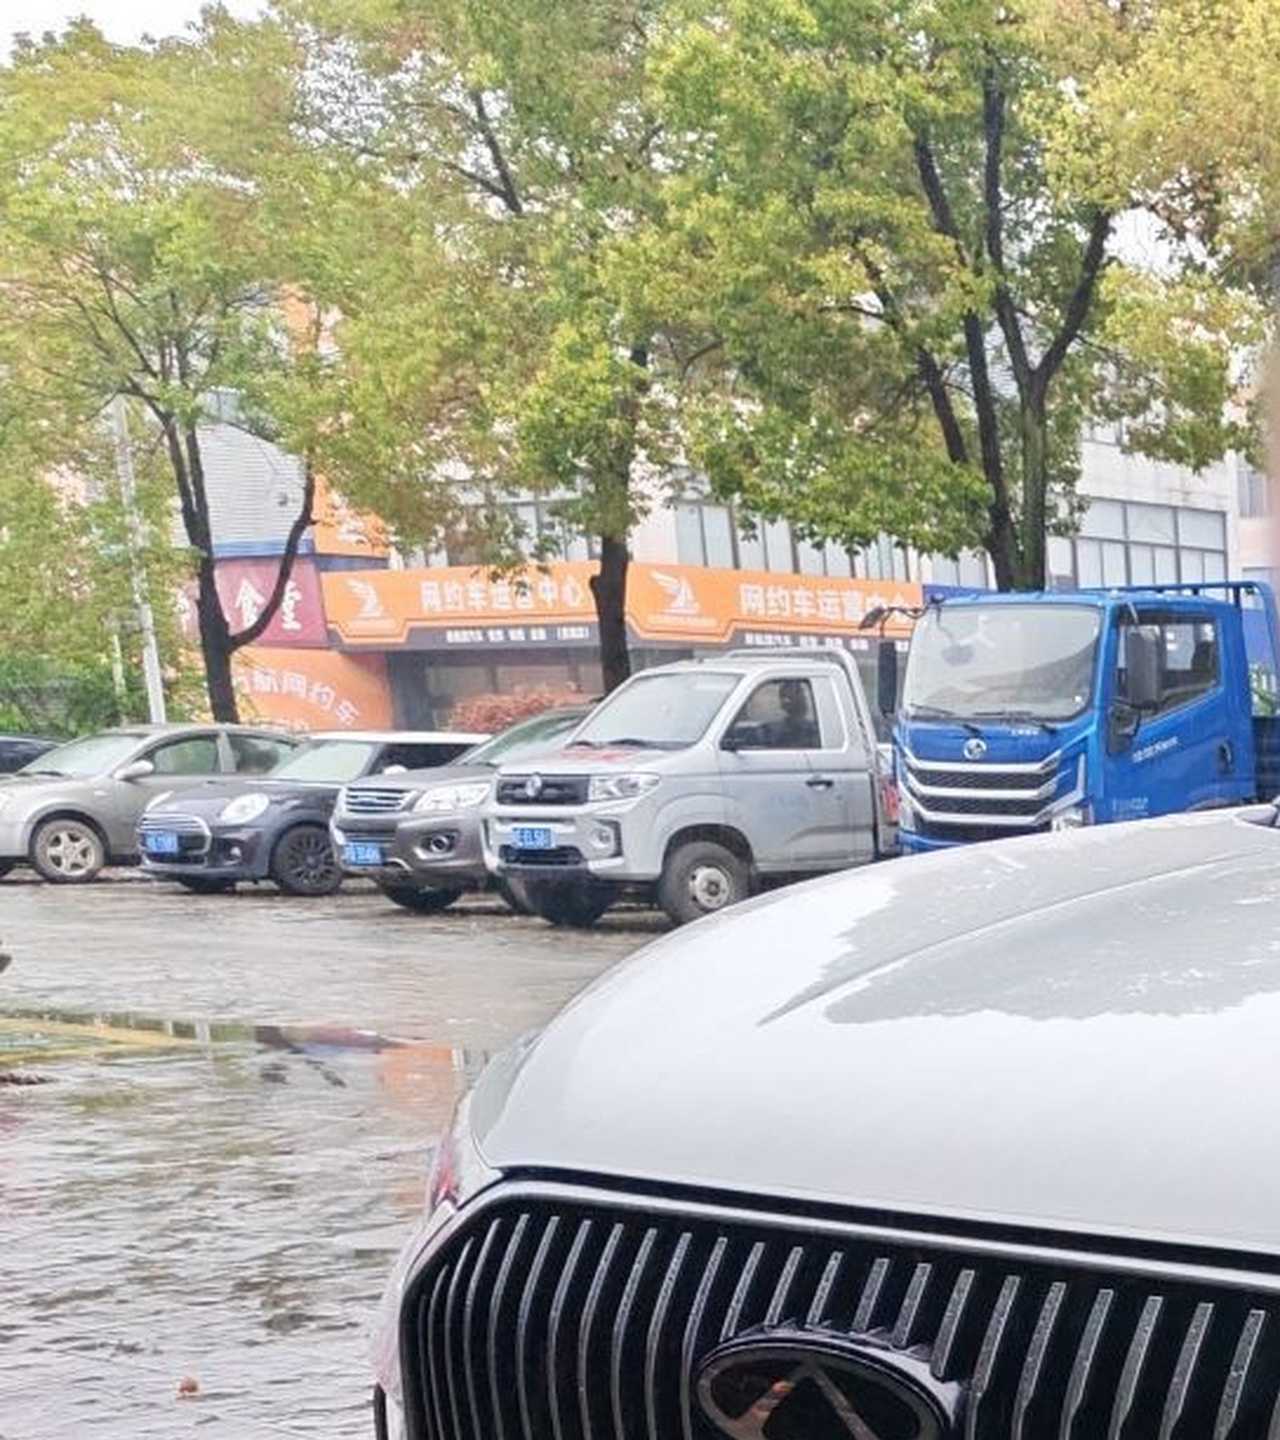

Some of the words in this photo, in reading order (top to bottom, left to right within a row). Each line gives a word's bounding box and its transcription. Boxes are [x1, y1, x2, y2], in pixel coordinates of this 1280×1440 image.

[420, 576, 584, 612] 网约车运营中心
